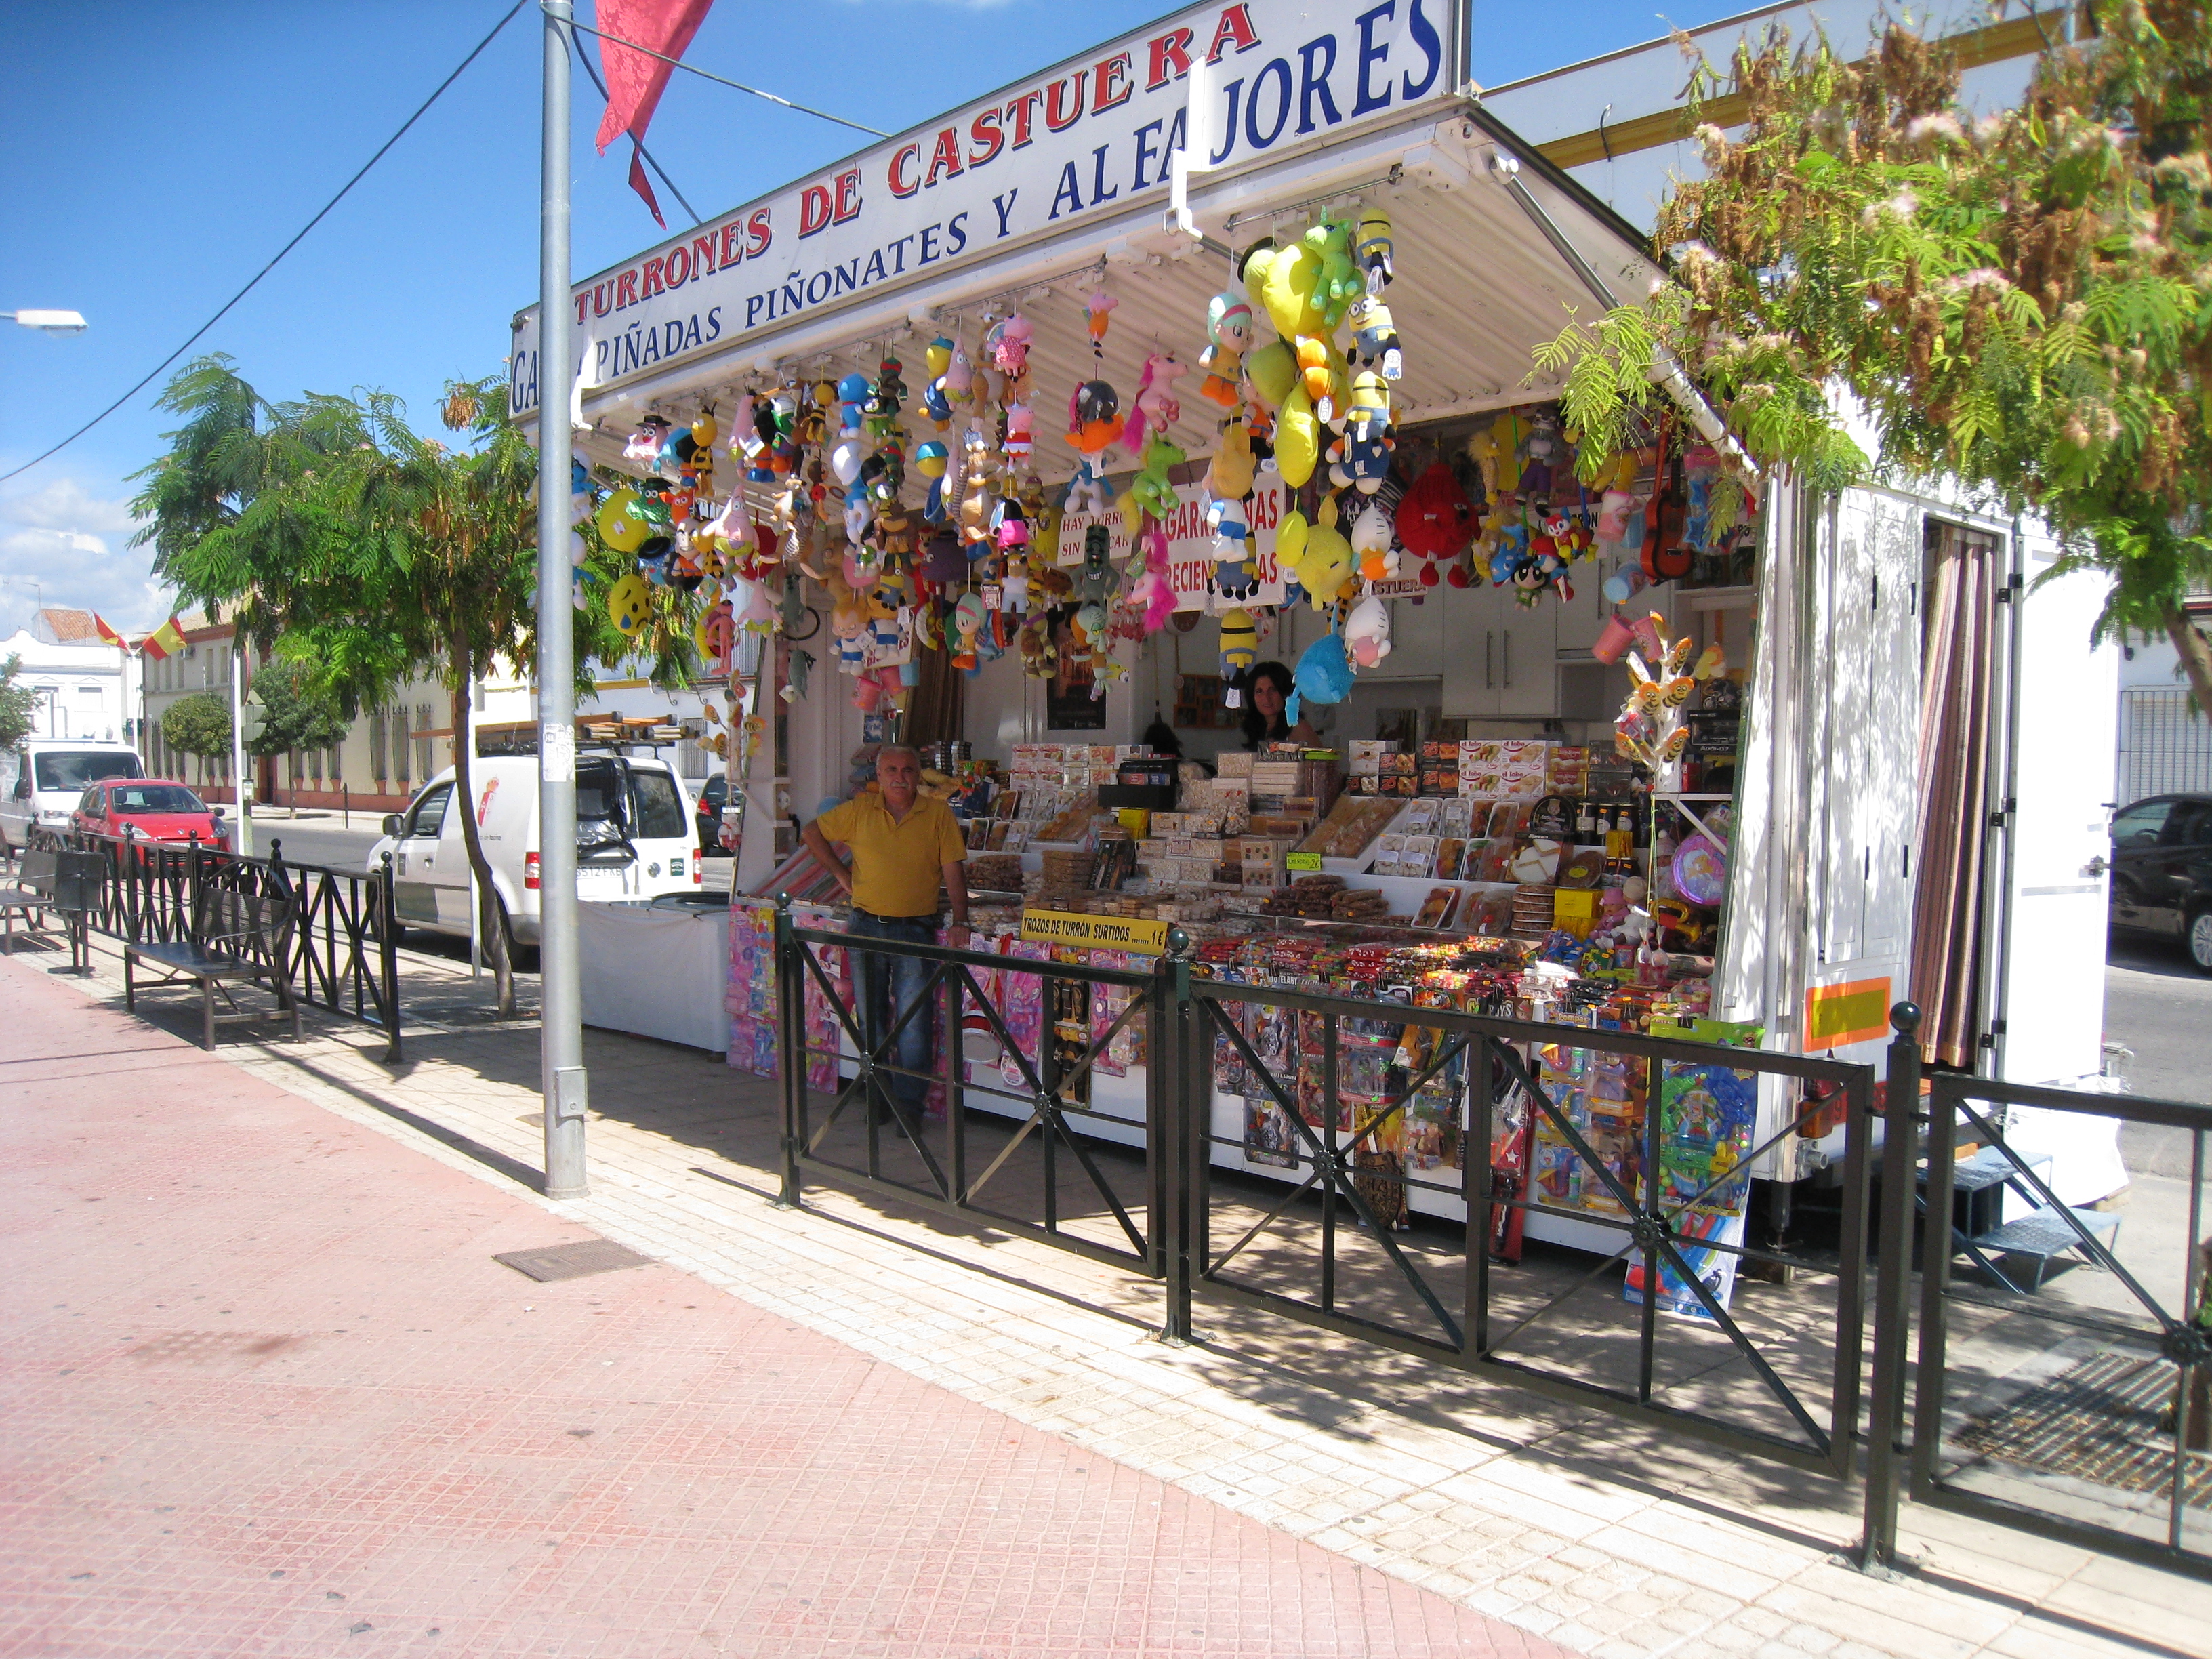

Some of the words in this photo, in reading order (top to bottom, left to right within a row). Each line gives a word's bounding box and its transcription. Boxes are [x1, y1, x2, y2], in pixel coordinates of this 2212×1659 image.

[575, 206, 772, 326] TURRONES
[798, 167, 863, 241] DE
[887, 2, 1262, 199] CASTUERA
[512, 306, 722, 414] GAPIÑADAS
[744, 211, 968, 329] PIÑONATES
[992, 188, 1019, 238] Y
[1062, 516, 1084, 532] HAY
[1061, 541, 1081, 556] SIN
[1023, 917, 1050, 934] TROZOS
[1050, 920, 1061, 935] DE
[1061, 918, 1091, 938] TURRÓN
[1093, 923, 1130, 943] SURTIDOS
